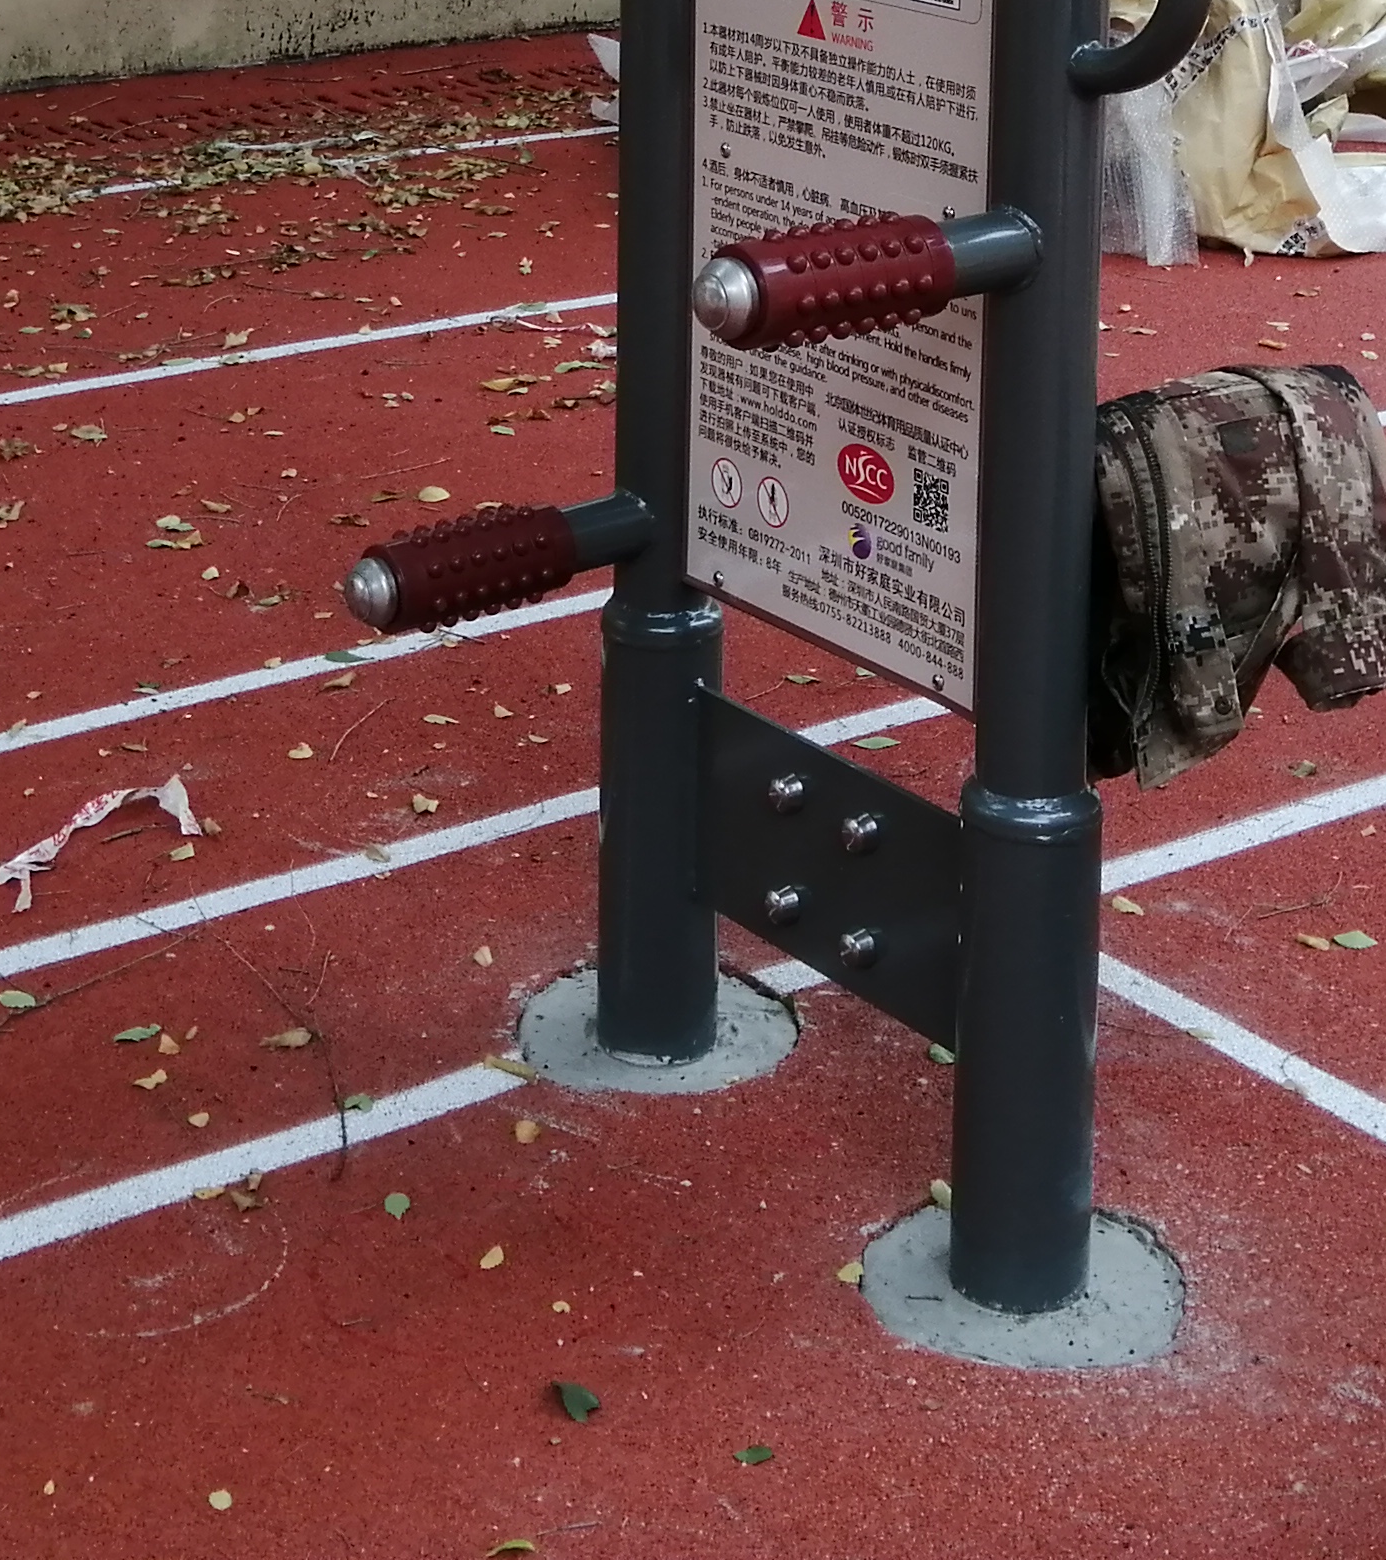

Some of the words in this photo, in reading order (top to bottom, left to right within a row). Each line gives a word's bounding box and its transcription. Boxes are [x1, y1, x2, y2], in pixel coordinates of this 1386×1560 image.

[831, 32, 873, 52] WARNING
[709, 177, 723, 191] For
[723, 184, 754, 201] persons
[755, 194, 778, 208] under
[791, 204, 813, 219] years
[710, 195, 740, 211] -endent
[741, 204, 780, 224] operation,
[782, 216, 795, 230] the
[710, 206, 734, 227] Elderly
[735, 217, 761, 233] people
[960, 307, 977, 320] uns
[910, 318, 939, 338] person
[939, 330, 956, 344] and
[957, 334, 972, 350] the
[773, 354, 787, 368] the
[788, 361, 828, 383] guidance.
[818, 343, 836, 360] after
[838, 349, 868, 373] drinking
[880, 364, 897, 381] with
[883, 337, 903, 354] Hold
[903, 344, 917, 359] the
[917, 348, 948, 371] handles
[949, 359, 971, 382] firmly
[806, 351, 824, 371] high
[826, 359, 849, 378] blood
[889, 382, 905, 400] and
[907, 389, 929, 408] other
[932, 399, 968, 423] diseases
[698, 392, 813, 448] 使用手机客户端扫描二维码并
[837, 417, 895, 451] 认证授权标志
[907, 444, 956, 478] 监管二维码
[841, 499, 961, 564] 0052017229013N00193
[876, 536, 902, 556] good
[904, 544, 934, 573] family
[818, 544, 965, 627] 深圳市好家庭实业有限公司
[897, 638, 963, 680] 4000-844-888
